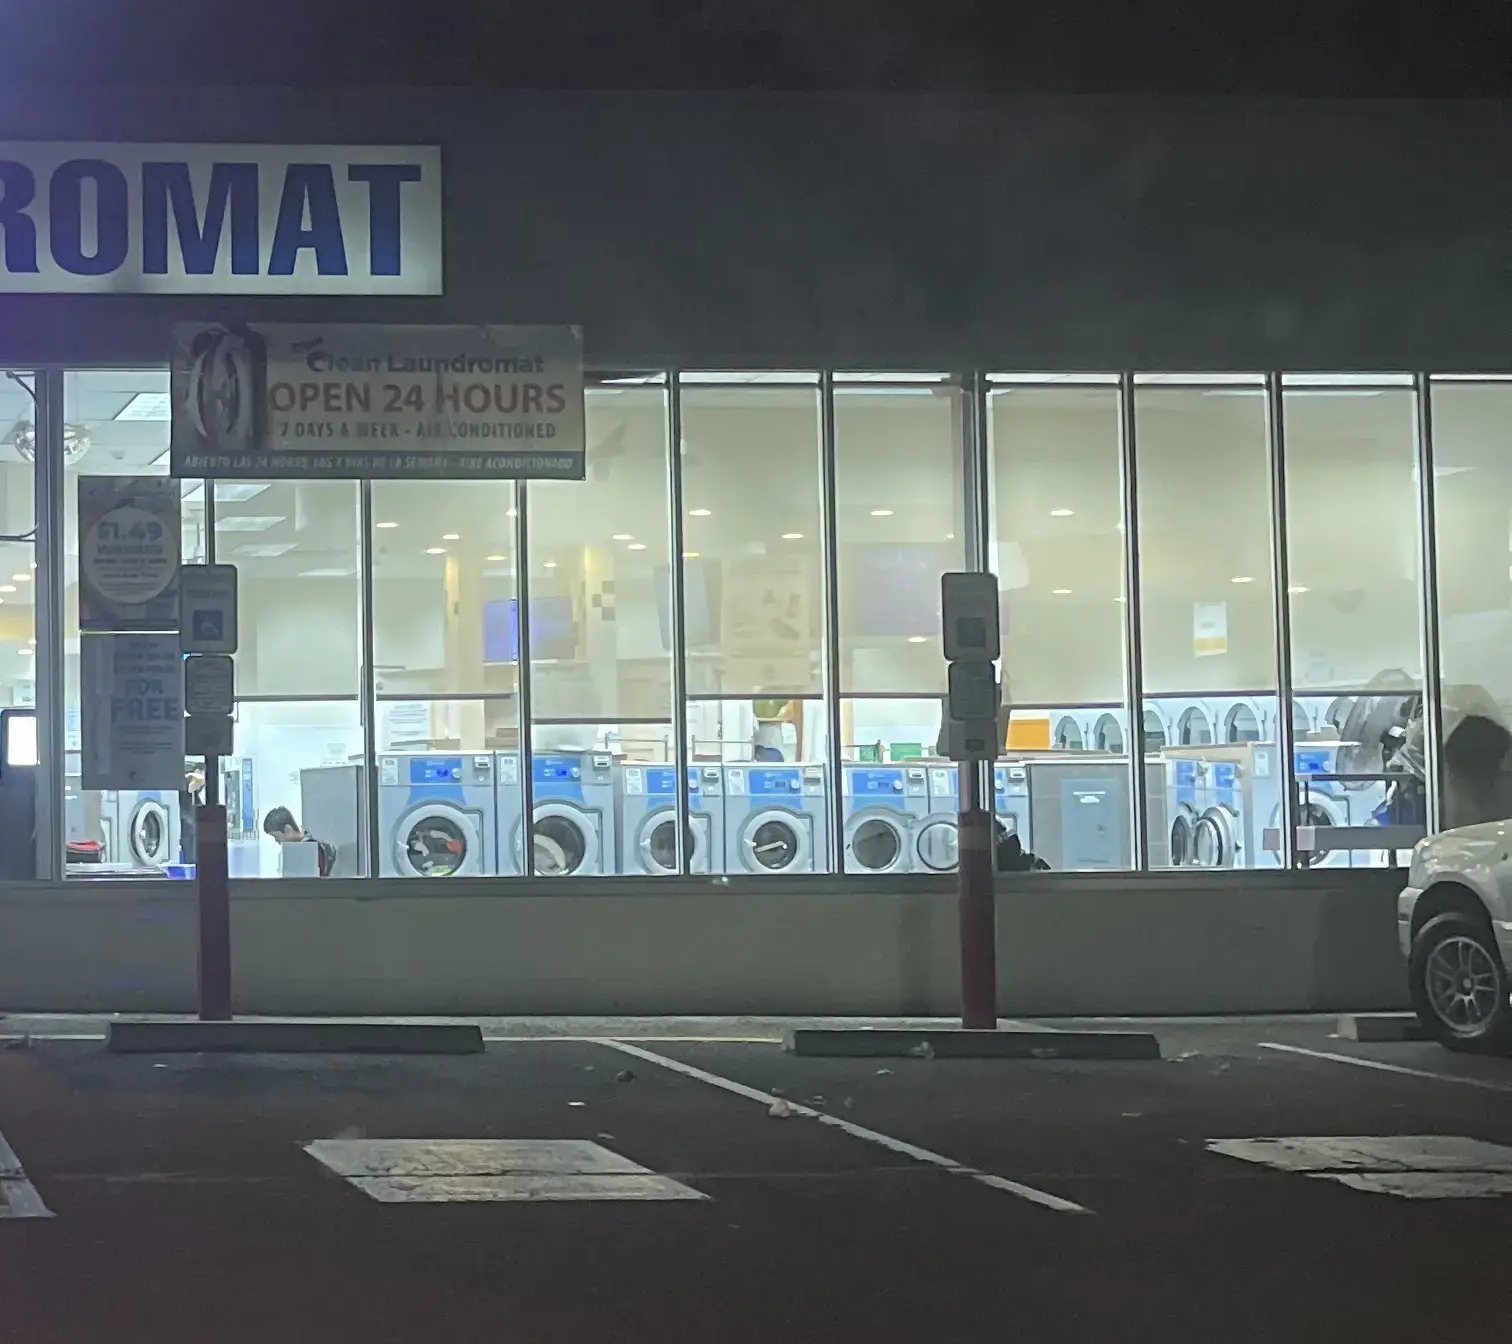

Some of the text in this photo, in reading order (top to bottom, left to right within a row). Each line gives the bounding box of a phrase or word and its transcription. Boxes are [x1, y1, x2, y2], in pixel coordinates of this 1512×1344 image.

[306, 350, 545, 374] Clean Laundromat
[268, 382, 567, 415] OPEN 24 HOURS
[295, 422, 334, 438] DAYS
[340, 422, 350, 438] A
[356, 422, 399, 438] WEEK
[416, 422, 442, 438] AIR
[448, 422, 556, 439] CONDITIONED
[111, 698, 180, 722] FREE
